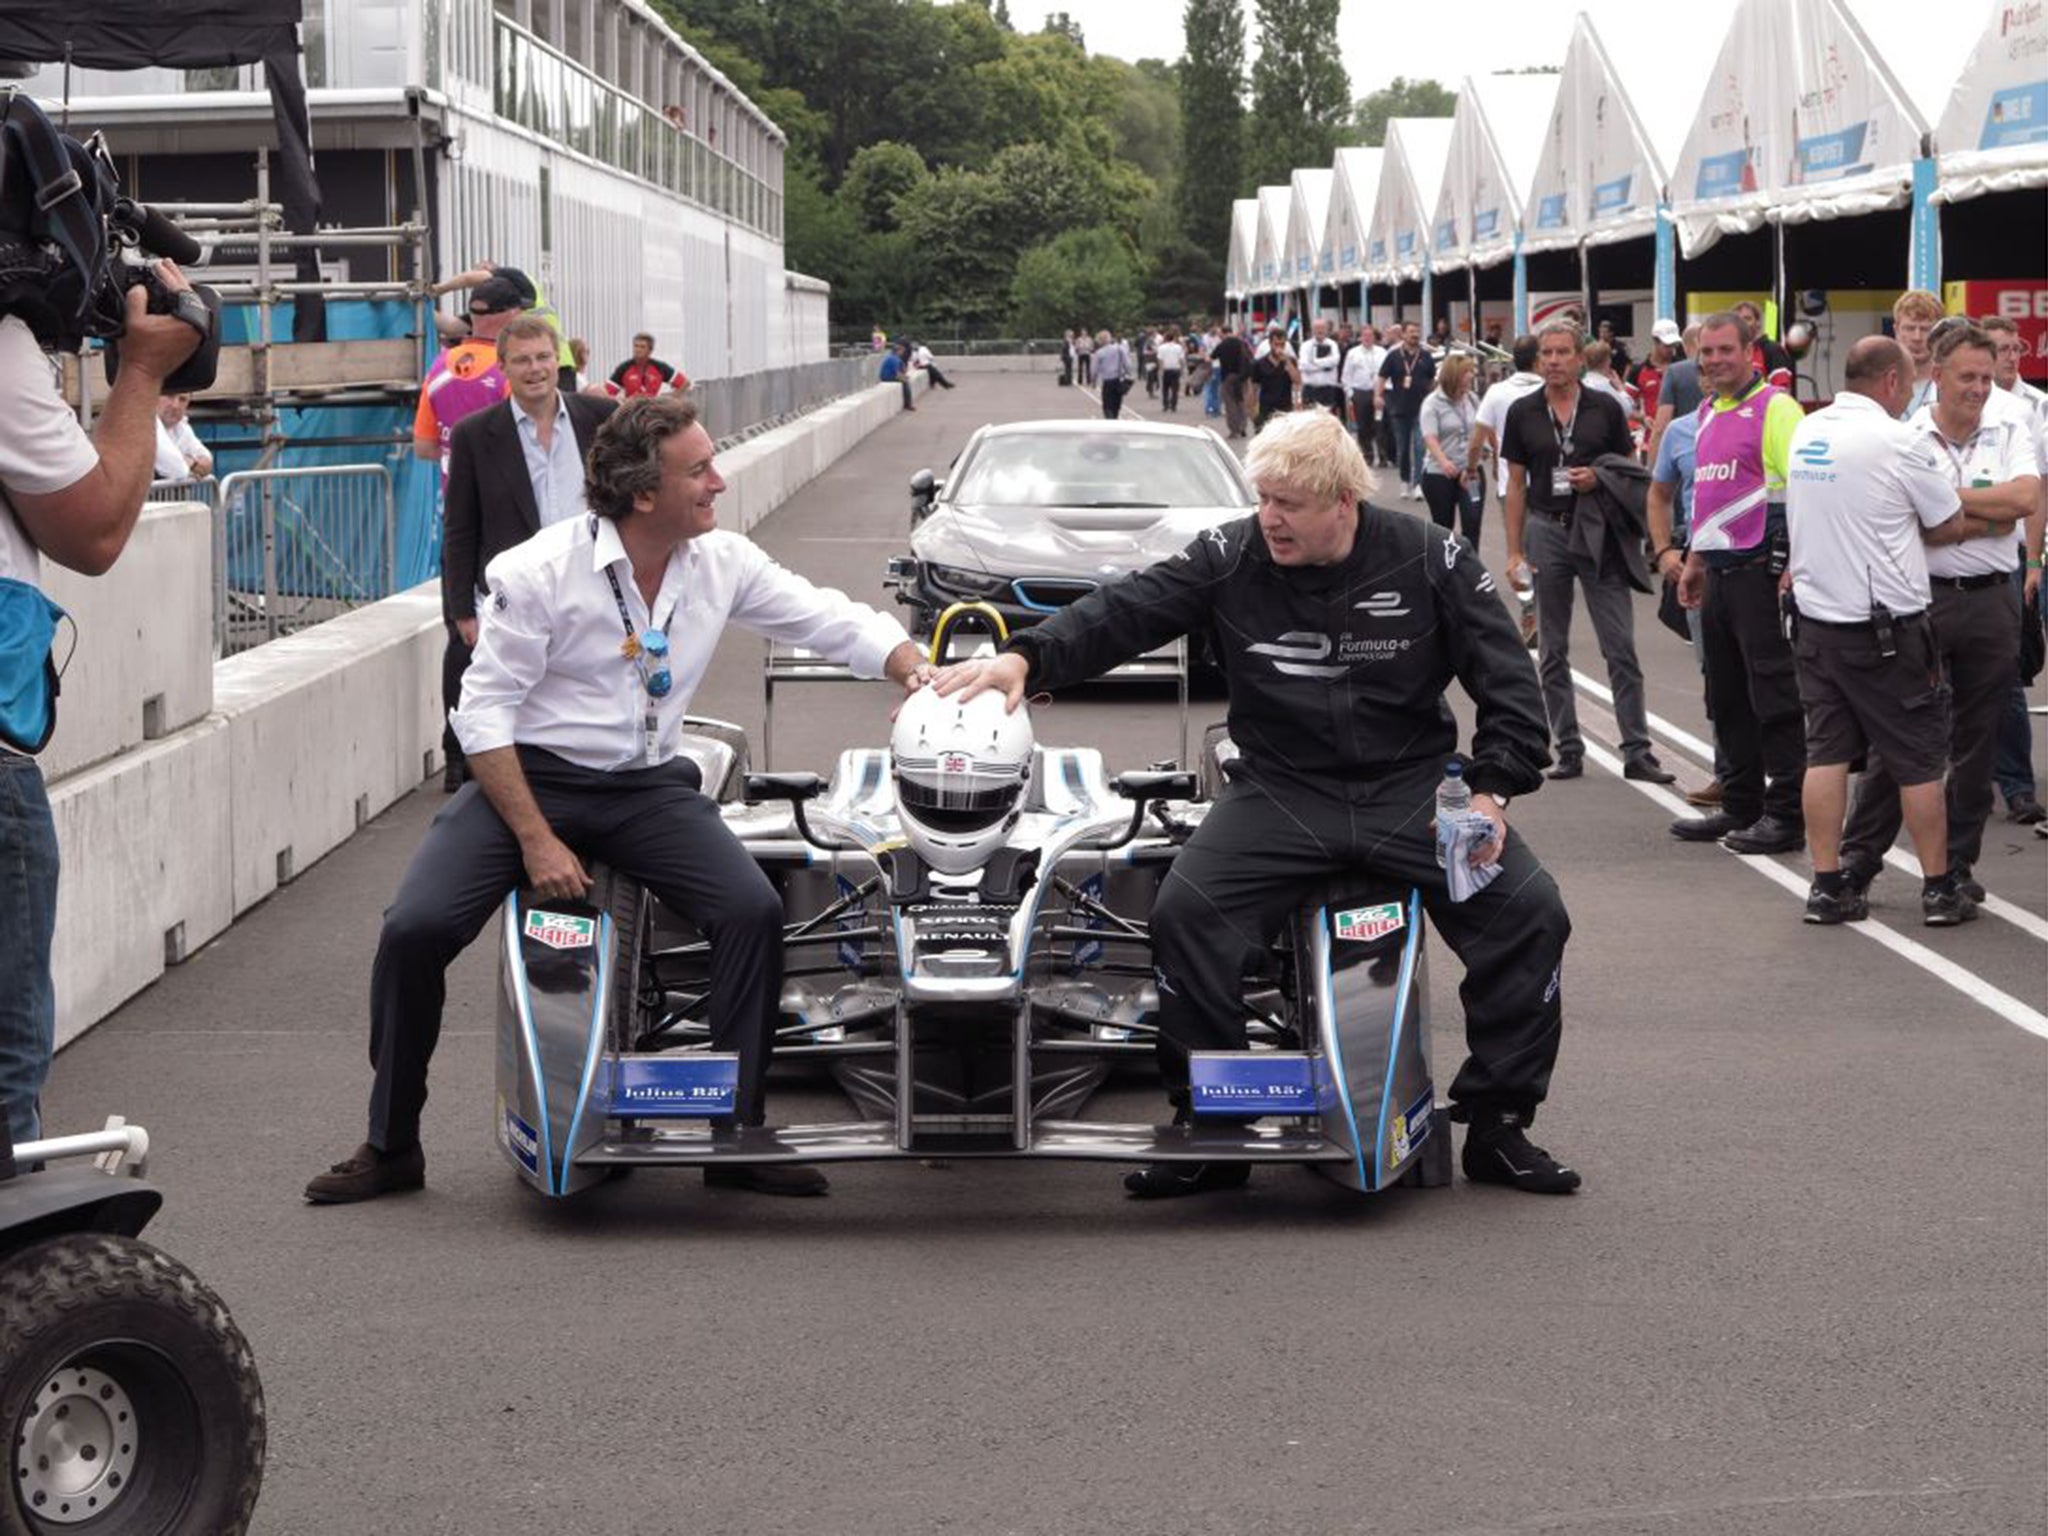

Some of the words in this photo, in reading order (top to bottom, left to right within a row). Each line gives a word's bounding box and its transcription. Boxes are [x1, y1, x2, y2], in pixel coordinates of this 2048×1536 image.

[914, 932, 1010, 940] RENAULT
[625, 1087, 685, 1098] Julius
[1202, 1085, 1261, 1097] Julius
